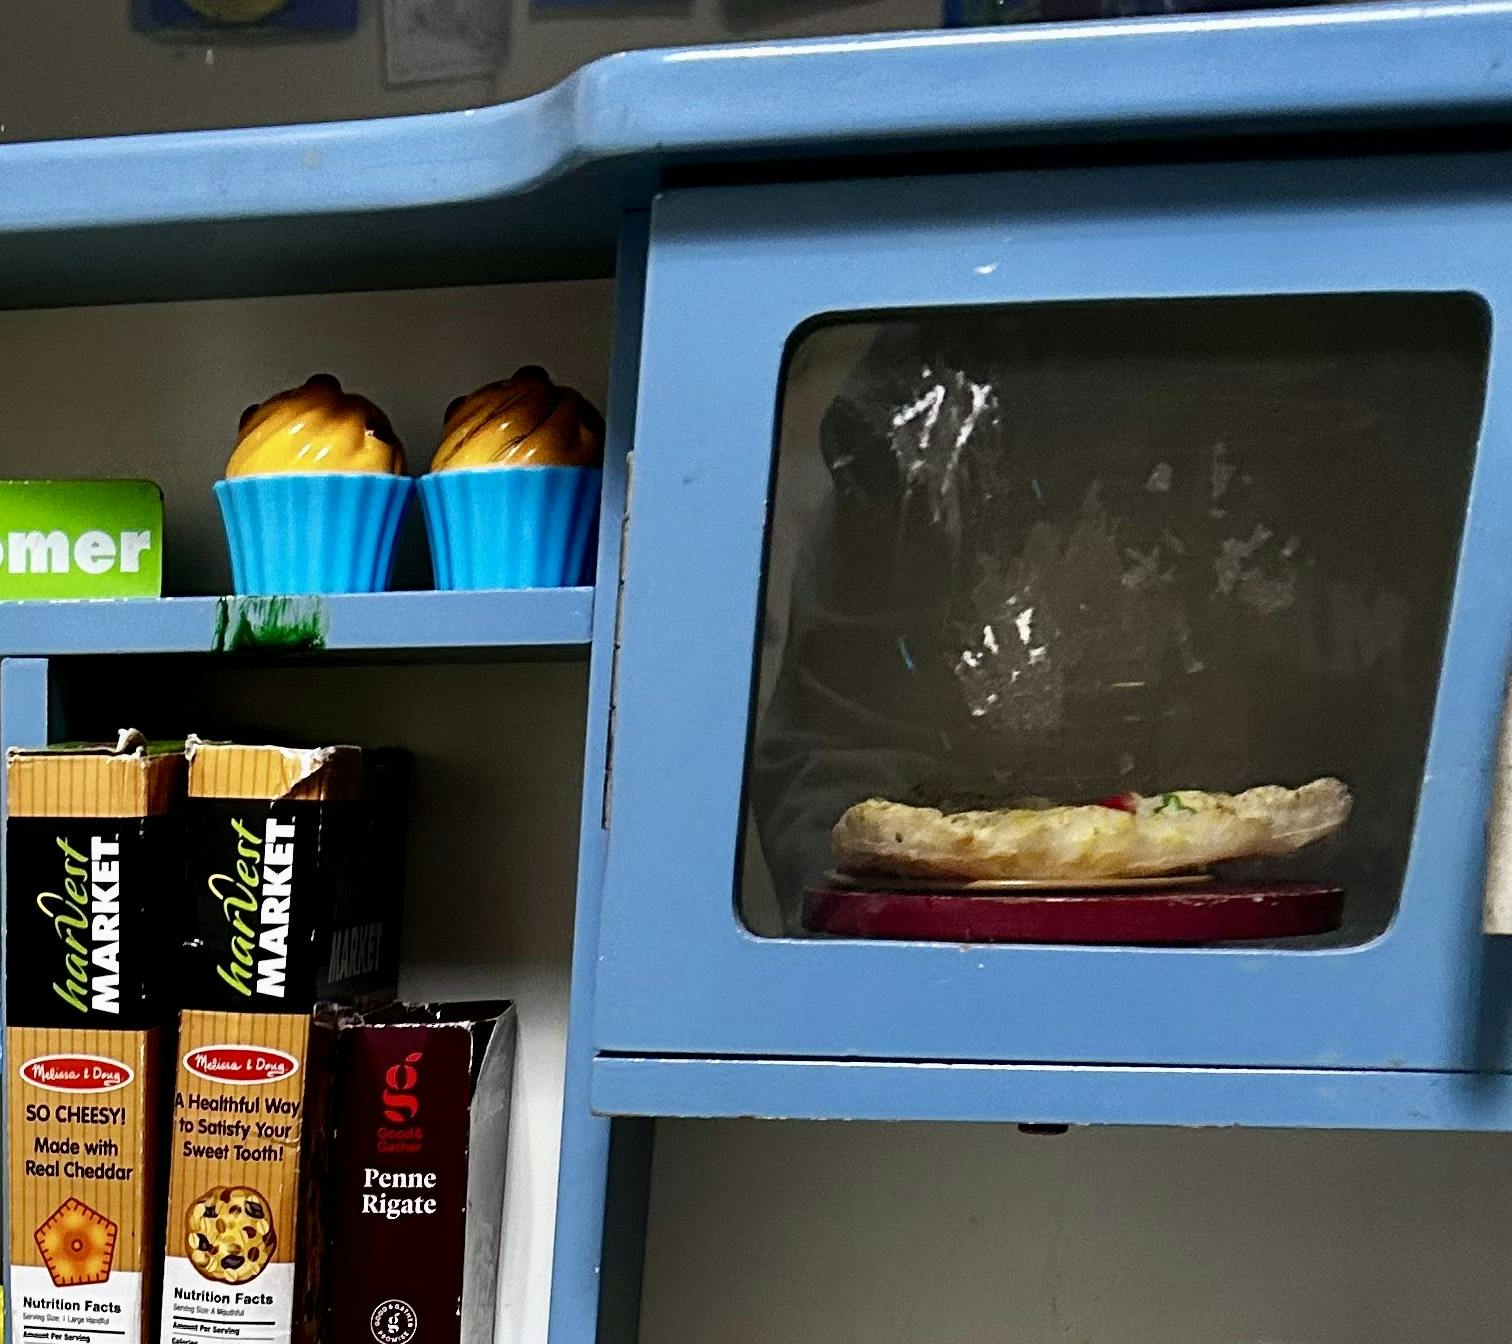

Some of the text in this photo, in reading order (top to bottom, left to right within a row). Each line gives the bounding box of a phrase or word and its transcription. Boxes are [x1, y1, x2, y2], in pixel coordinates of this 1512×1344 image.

[208, 818, 263, 996] harvest
[256, 818, 295, 997] MARKET
[37, 836, 88, 1012] harvest
[91, 836, 119, 1014] MARKET
[328, 922, 383, 984] MARKET
[32, 1064, 80, 1082] Melissa
[93, 1067, 120, 1086] Doug
[195, 1054, 242, 1072] Melissa
[256, 1057, 285, 1077] Doug
[26, 1104, 126, 1126] SO CHEESY!
[175, 1092, 301, 1118] A Healthful Way
[179, 1117, 292, 1140] to Satisfy Your
[34, 1137, 118, 1157] Made with
[183, 1140, 284, 1162] Sweet Tooth!
[25, 1159, 133, 1180] Real Cheddar
[364, 1168, 437, 1188] Penne
[361, 1193, 437, 1219] Rigate
[23, 1296, 122, 1313] Nutrition Facts
[174, 1287, 273, 1305] Nutrition Facts
[23, 1331, 90, 1343] Amount Per Serving
[173, 1322, 198, 1331] Amount
[213, 1326, 240, 1336] Serving
